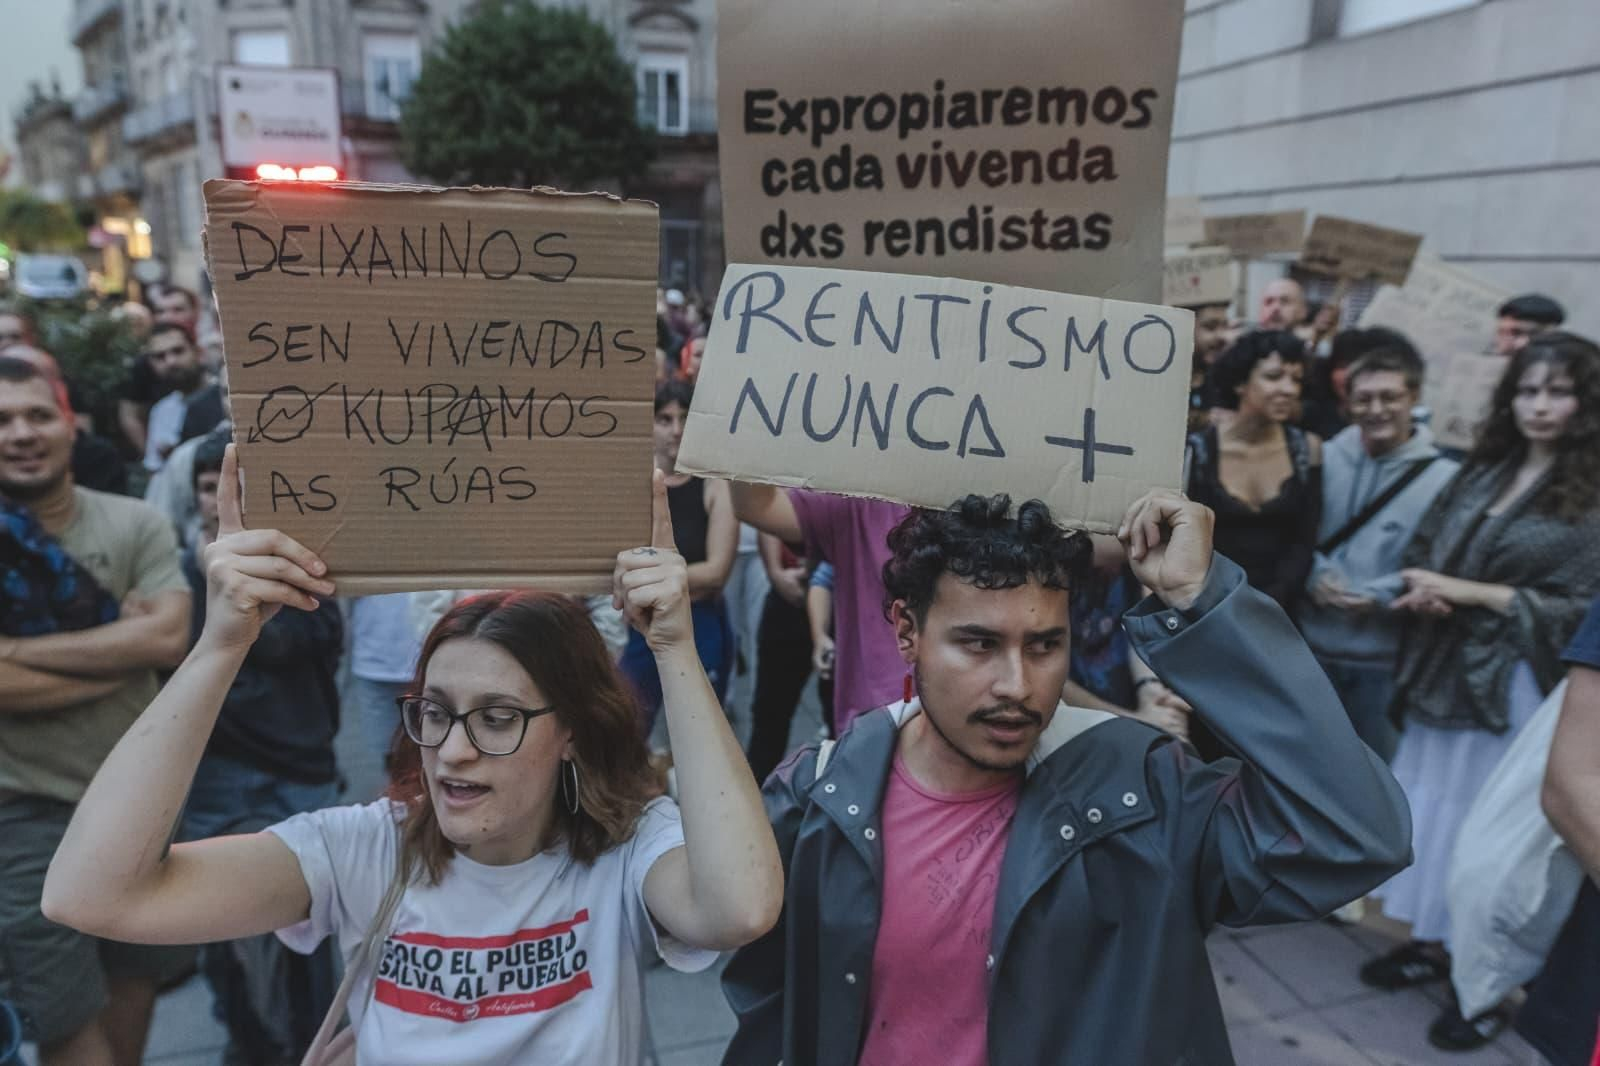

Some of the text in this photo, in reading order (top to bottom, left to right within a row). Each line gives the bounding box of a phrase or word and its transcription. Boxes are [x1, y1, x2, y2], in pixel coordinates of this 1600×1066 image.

[743, 79, 1158, 147] Expropiaremos
[761, 138, 1119, 197] cada vivenda
[232, 220, 577, 283] DEIXANNOS
[759, 205, 1113, 258] dxs rendistas
[242, 319, 646, 369] SEN VIVENDAS
[730, 372, 1006, 459] NUNCA
[271, 457, 537, 515] AS RÚAS
[378, 950, 588, 1000] SALVA AL PUEBLO
[449, 951, 478, 975] EL
